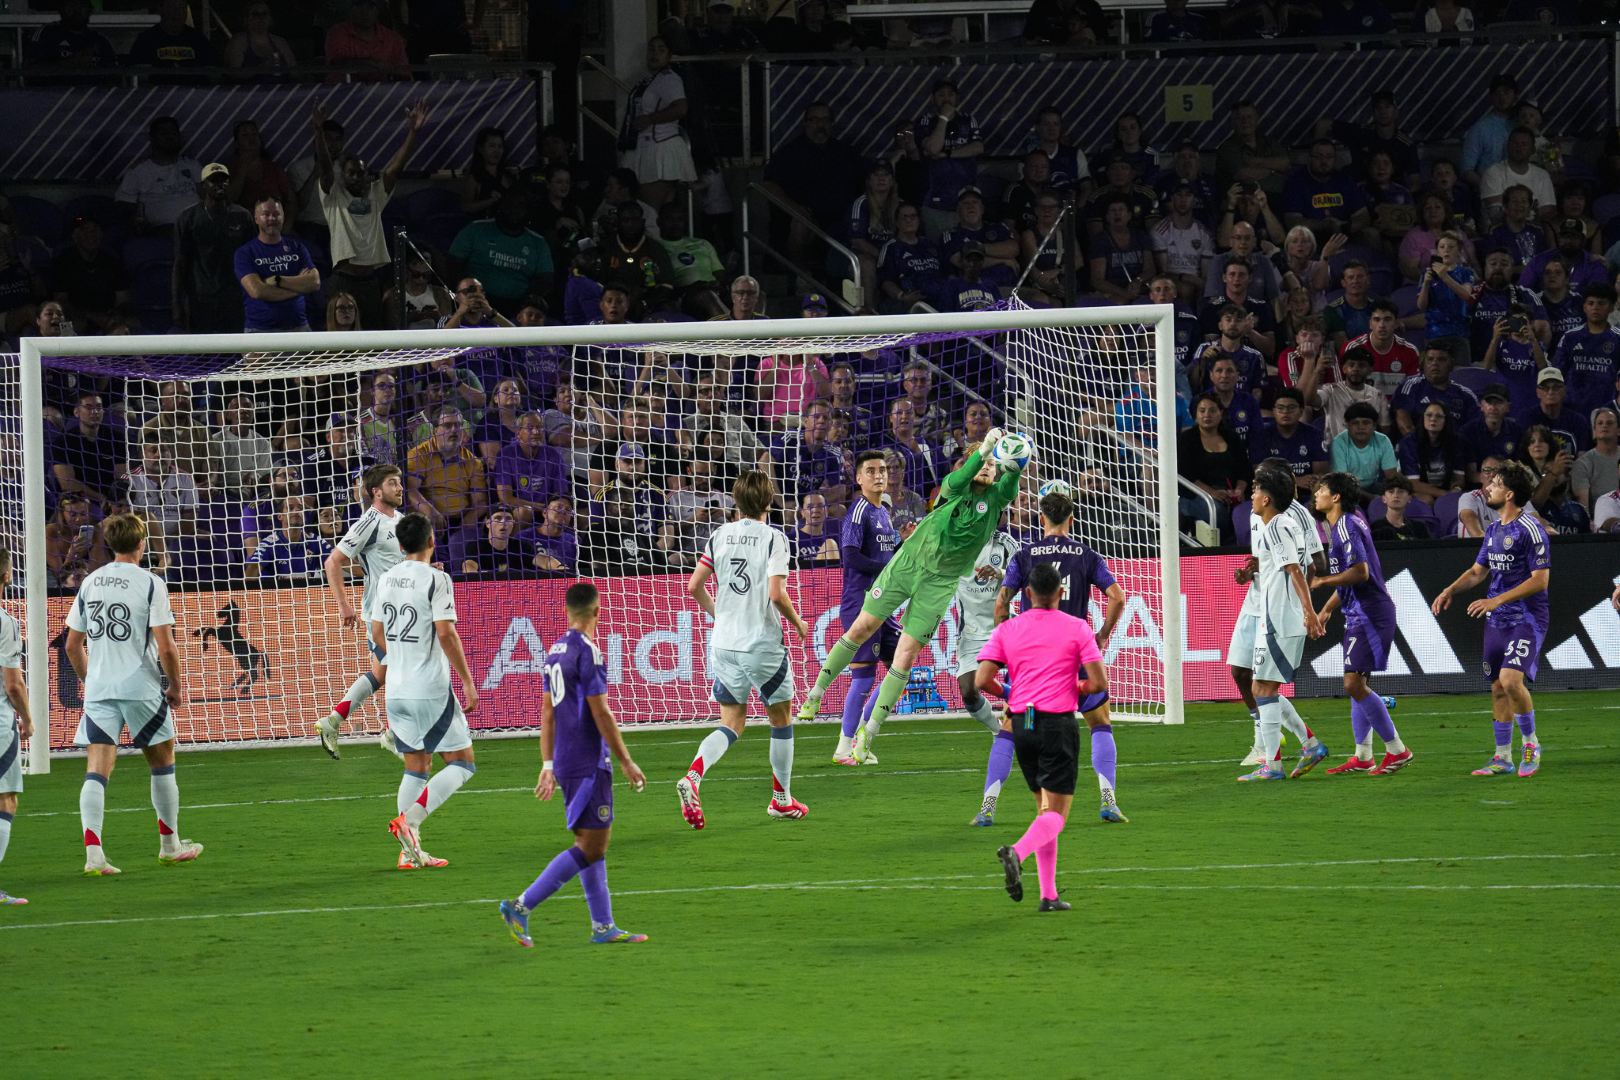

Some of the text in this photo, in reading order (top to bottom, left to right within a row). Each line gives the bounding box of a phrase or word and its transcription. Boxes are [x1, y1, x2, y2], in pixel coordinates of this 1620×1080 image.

[1183, 93, 1193, 112] 5
[255, 253, 300, 266] ORLANDO
[269, 263, 289, 272] CITY
[1573, 355, 1613, 367] ORLANDO
[1575, 362, 1609, 374] HEALTH
[1030, 544, 1084, 556] BREKALO
[93, 576, 130, 590] CUPPS
[385, 576, 416, 590] PINEDA
[729, 558, 751, 596] 3
[87, 600, 132, 643] 38
[382, 601, 420, 643] 22
